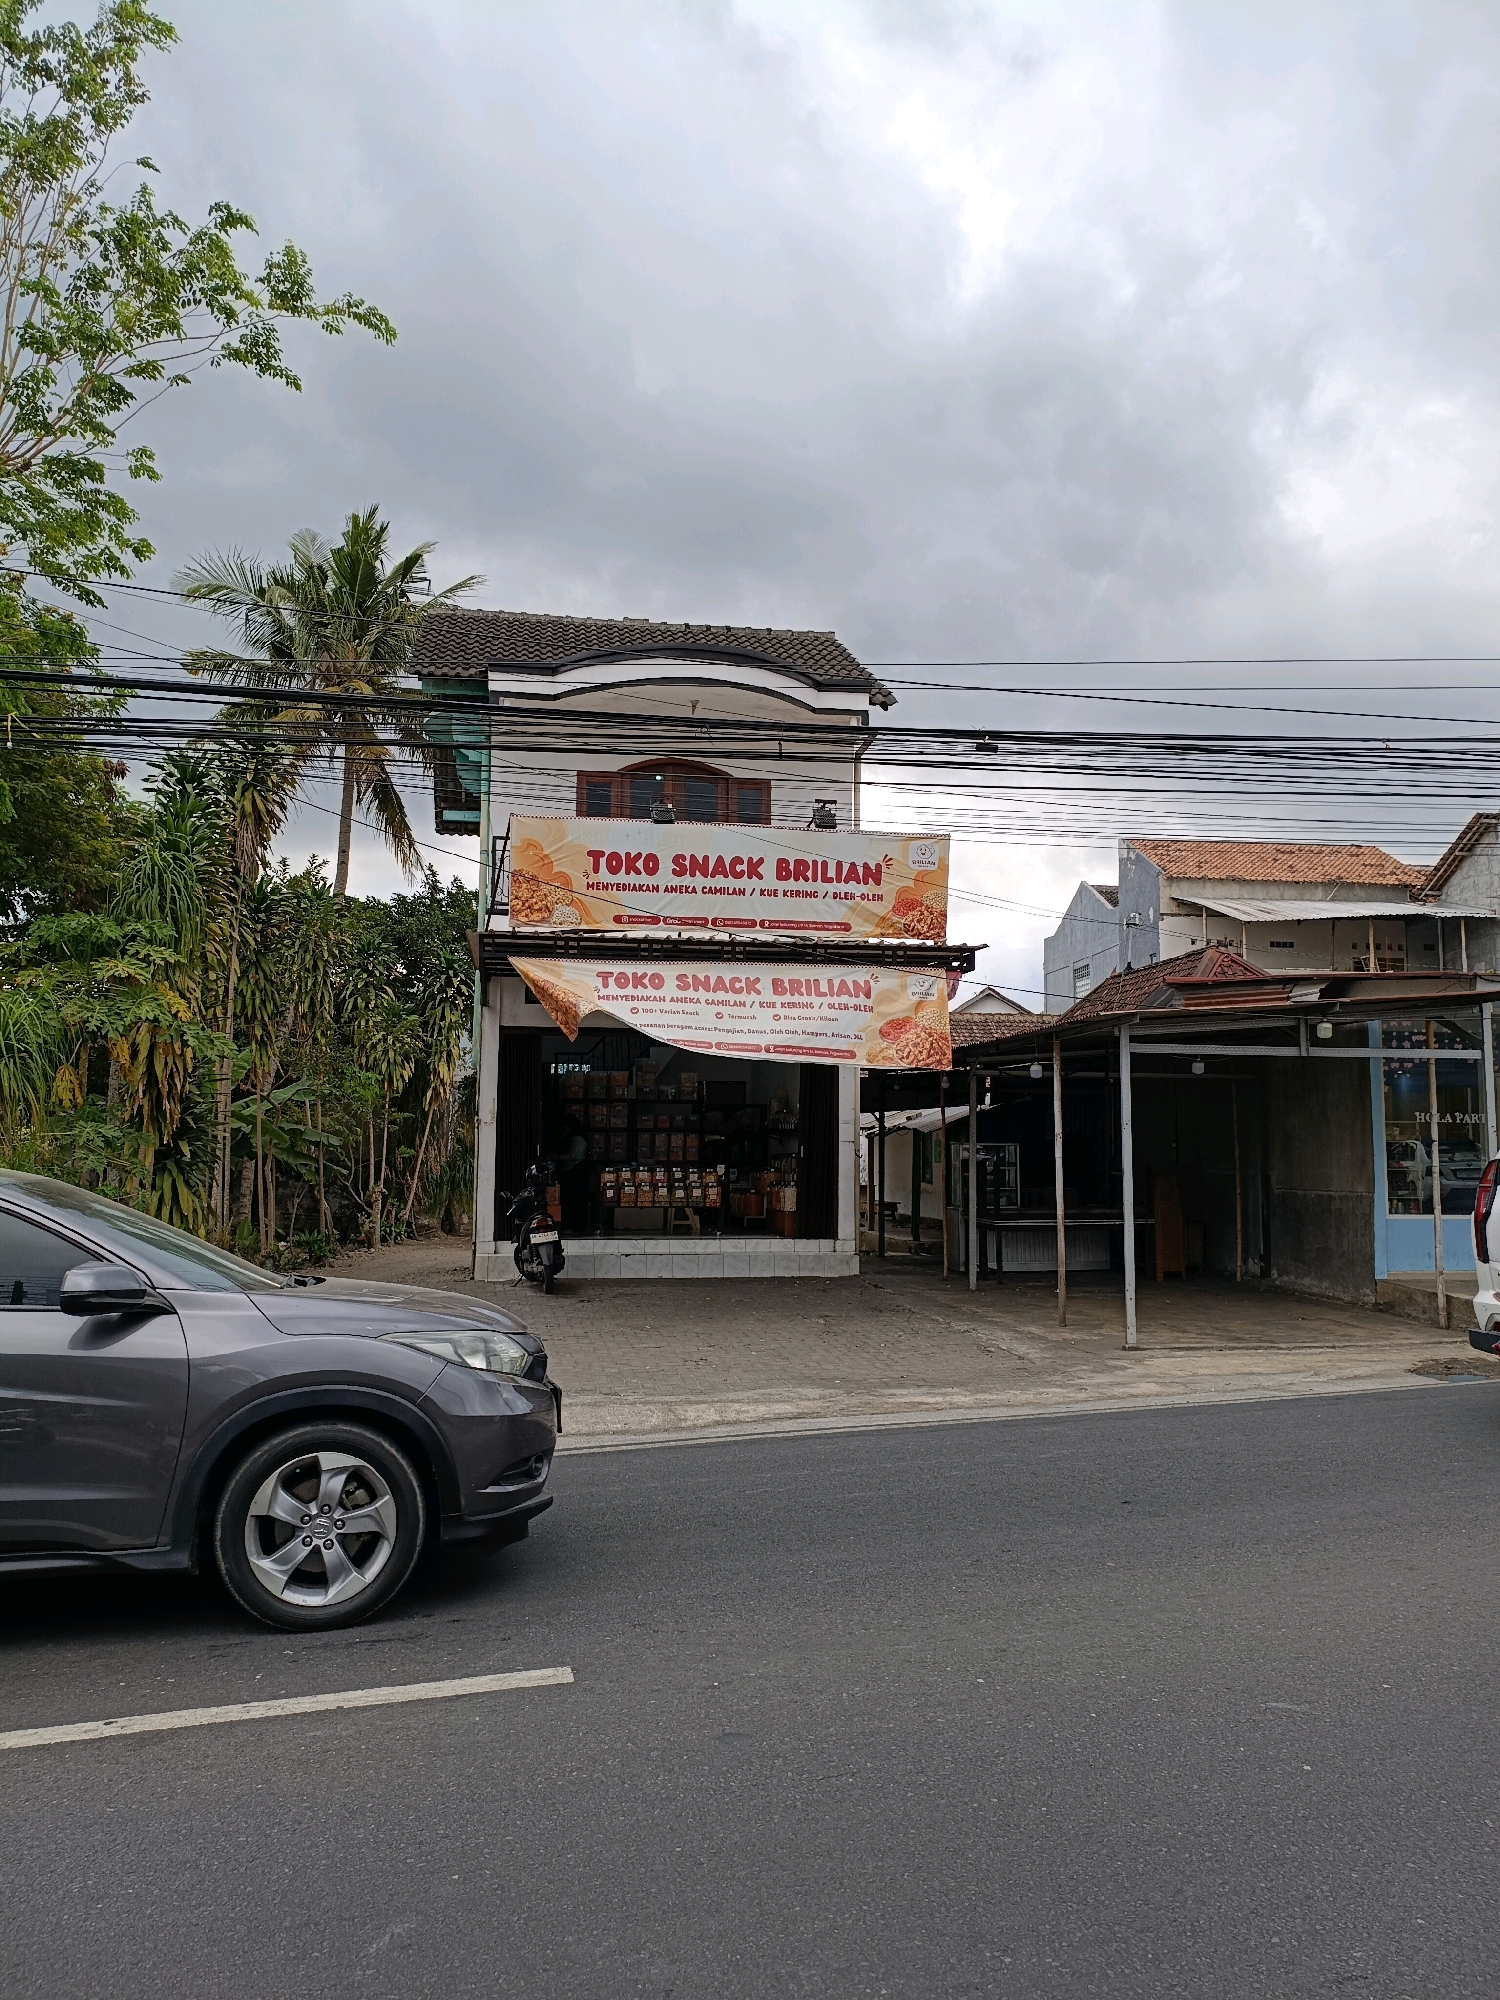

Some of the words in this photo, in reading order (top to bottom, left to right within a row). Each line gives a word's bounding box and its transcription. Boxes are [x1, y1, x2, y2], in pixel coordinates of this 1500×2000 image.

[586, 849, 660, 877] TOKO
[671, 853, 765, 880] SNACK
[775, 857, 883, 887] BRILIAN
[586, 881, 660, 893] MENYEDIAKAN
[663, 884, 698, 895] ANEKA
[701, 886, 746, 896] CAMILAN
[749, 887, 756, 897] /
[760, 888, 779, 898] KUE
[782, 889, 819, 899] KERING
[822, 890, 829, 900] /
[832, 891, 884, 902] OLEH-OLEH
[596, 971, 666, 991] TOKO
[675, 974, 761, 996] SNACK
[771, 977, 872, 1000] BRILIAN
[597, 994, 667, 1003] MENYEDIAKAN
[669, 996, 702, 1005] ANEKA
[704, 998, 747, 1008] CAMILAN
[749, 1000, 756, 1009] /
[759, 1000, 777, 1009] KUE
[780, 1001, 815, 1010] KERING
[818, 1002, 824, 1010] /
[827, 1002, 874, 1014] OLEH-OLEH
[659, 1008, 681, 1016] Varian
[681, 1009, 700, 1017] Snack
